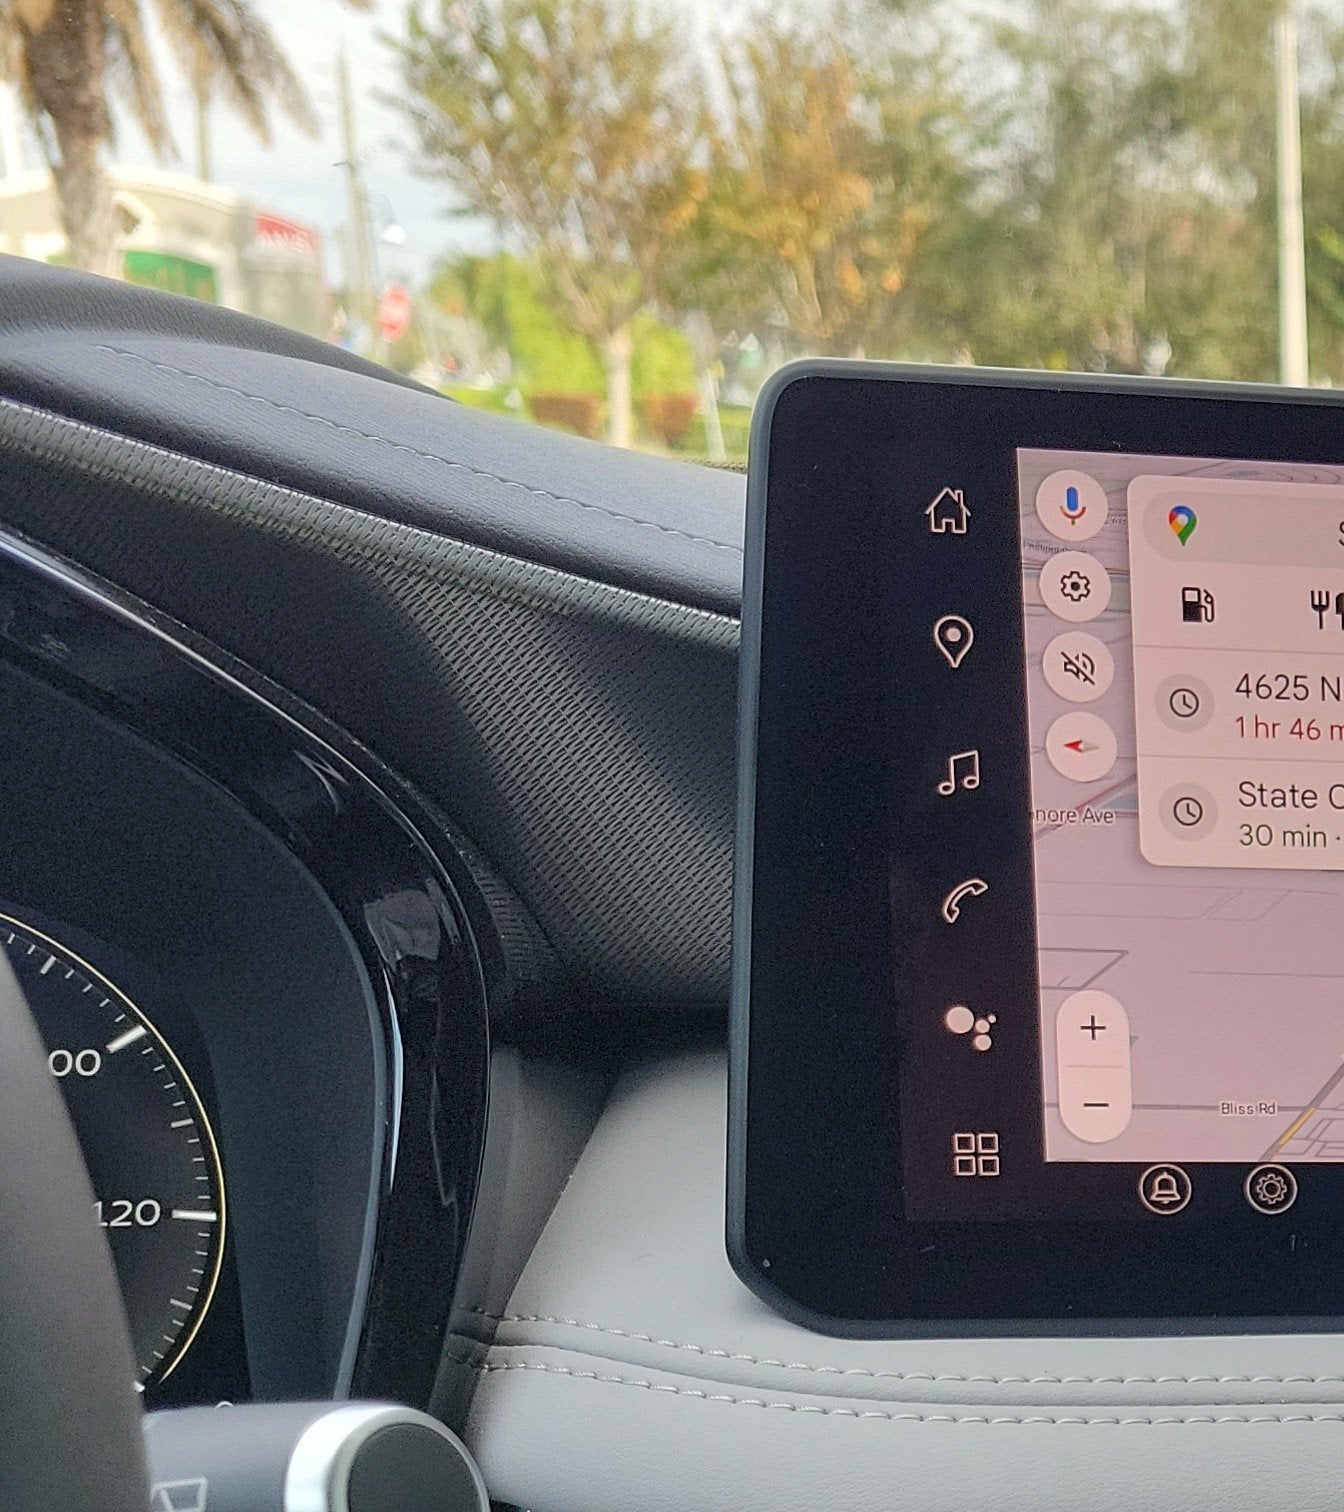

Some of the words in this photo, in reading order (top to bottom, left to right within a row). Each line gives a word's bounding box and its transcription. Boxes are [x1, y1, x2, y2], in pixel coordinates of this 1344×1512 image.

[1235, 672, 1310, 702] 4625
[1321, 675, 1342, 702] N
[1235, 715, 1246, 738] 1
[1254, 715, 1281, 739] hr
[1289, 717, 1322, 741] 46
[1238, 780, 1319, 810] State
[1035, 808, 1078, 824] nore
[1082, 807, 1115, 824] Ave
[1238, 824, 1273, 848] 30
[1281, 824, 1328, 850] min
[48, 1049, 101, 1077] 00
[1220, 1102, 1255, 1115] Bliss
[1258, 1101, 1276, 1115] Rd
[92, 1199, 162, 1227] 120
